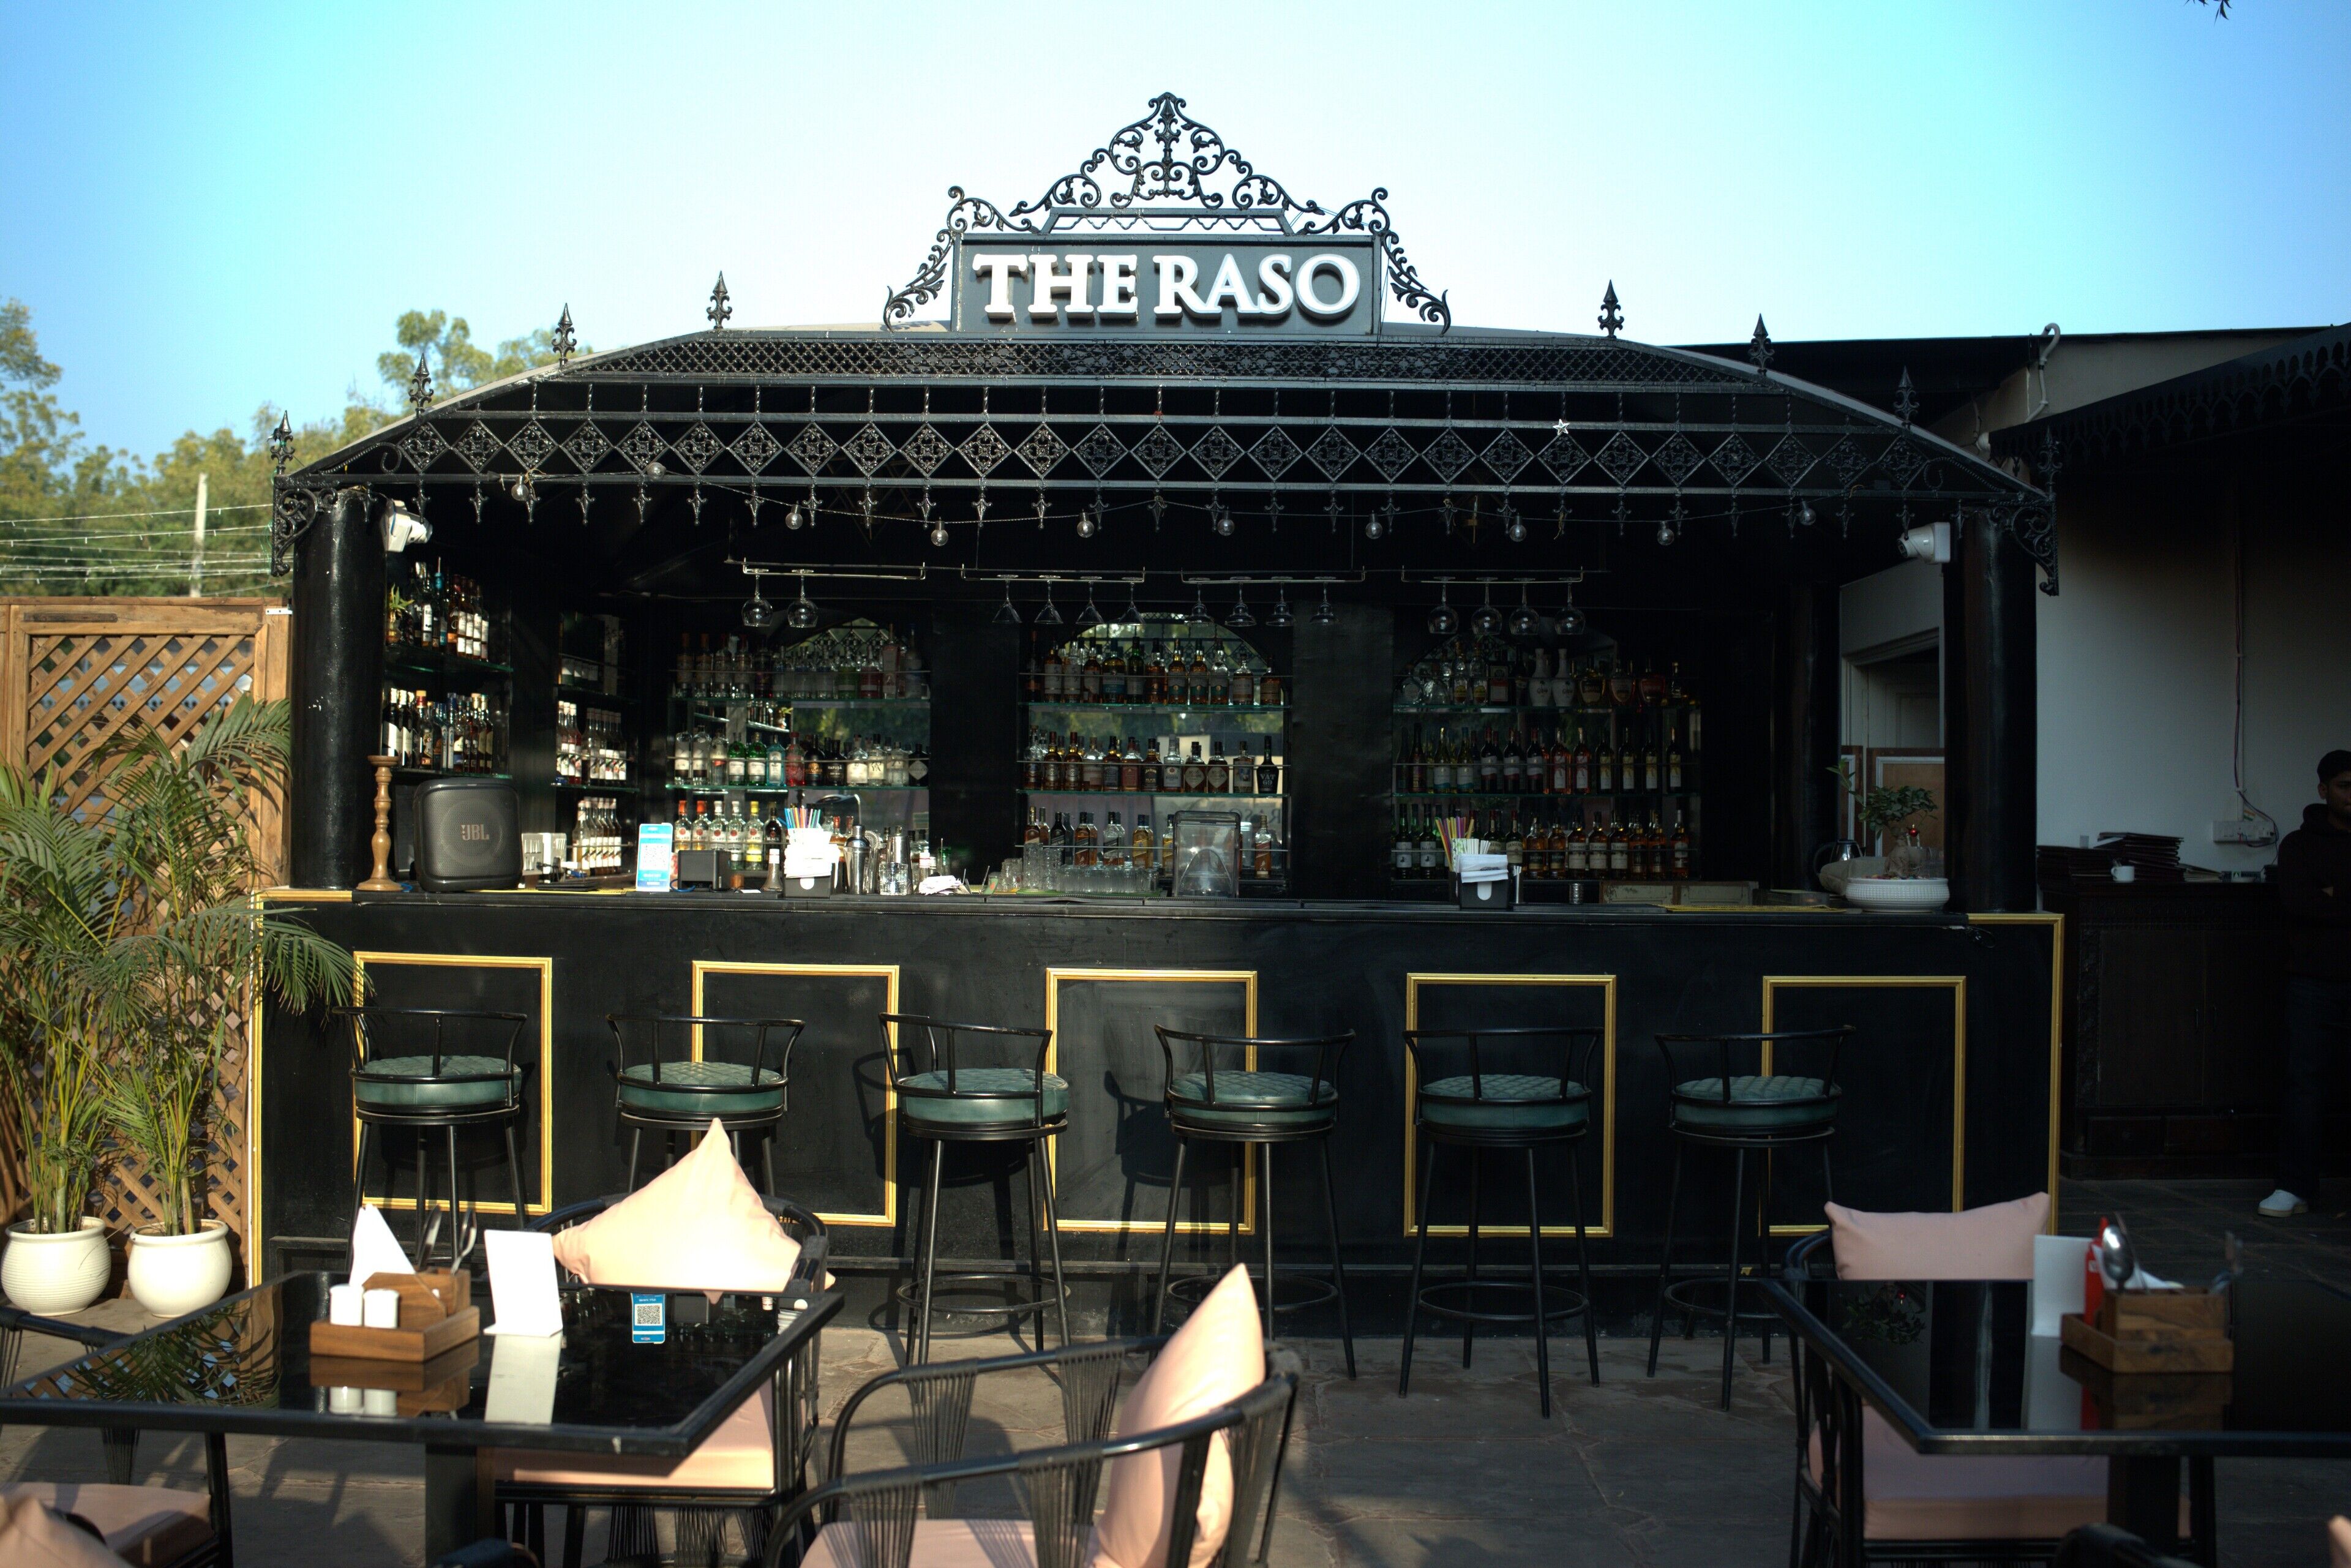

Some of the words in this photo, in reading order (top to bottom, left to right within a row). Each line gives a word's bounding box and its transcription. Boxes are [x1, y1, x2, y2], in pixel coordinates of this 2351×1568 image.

[972, 253, 1139, 318] THE
[1153, 253, 1360, 319] RASO
[461, 824, 490, 841] JBL
